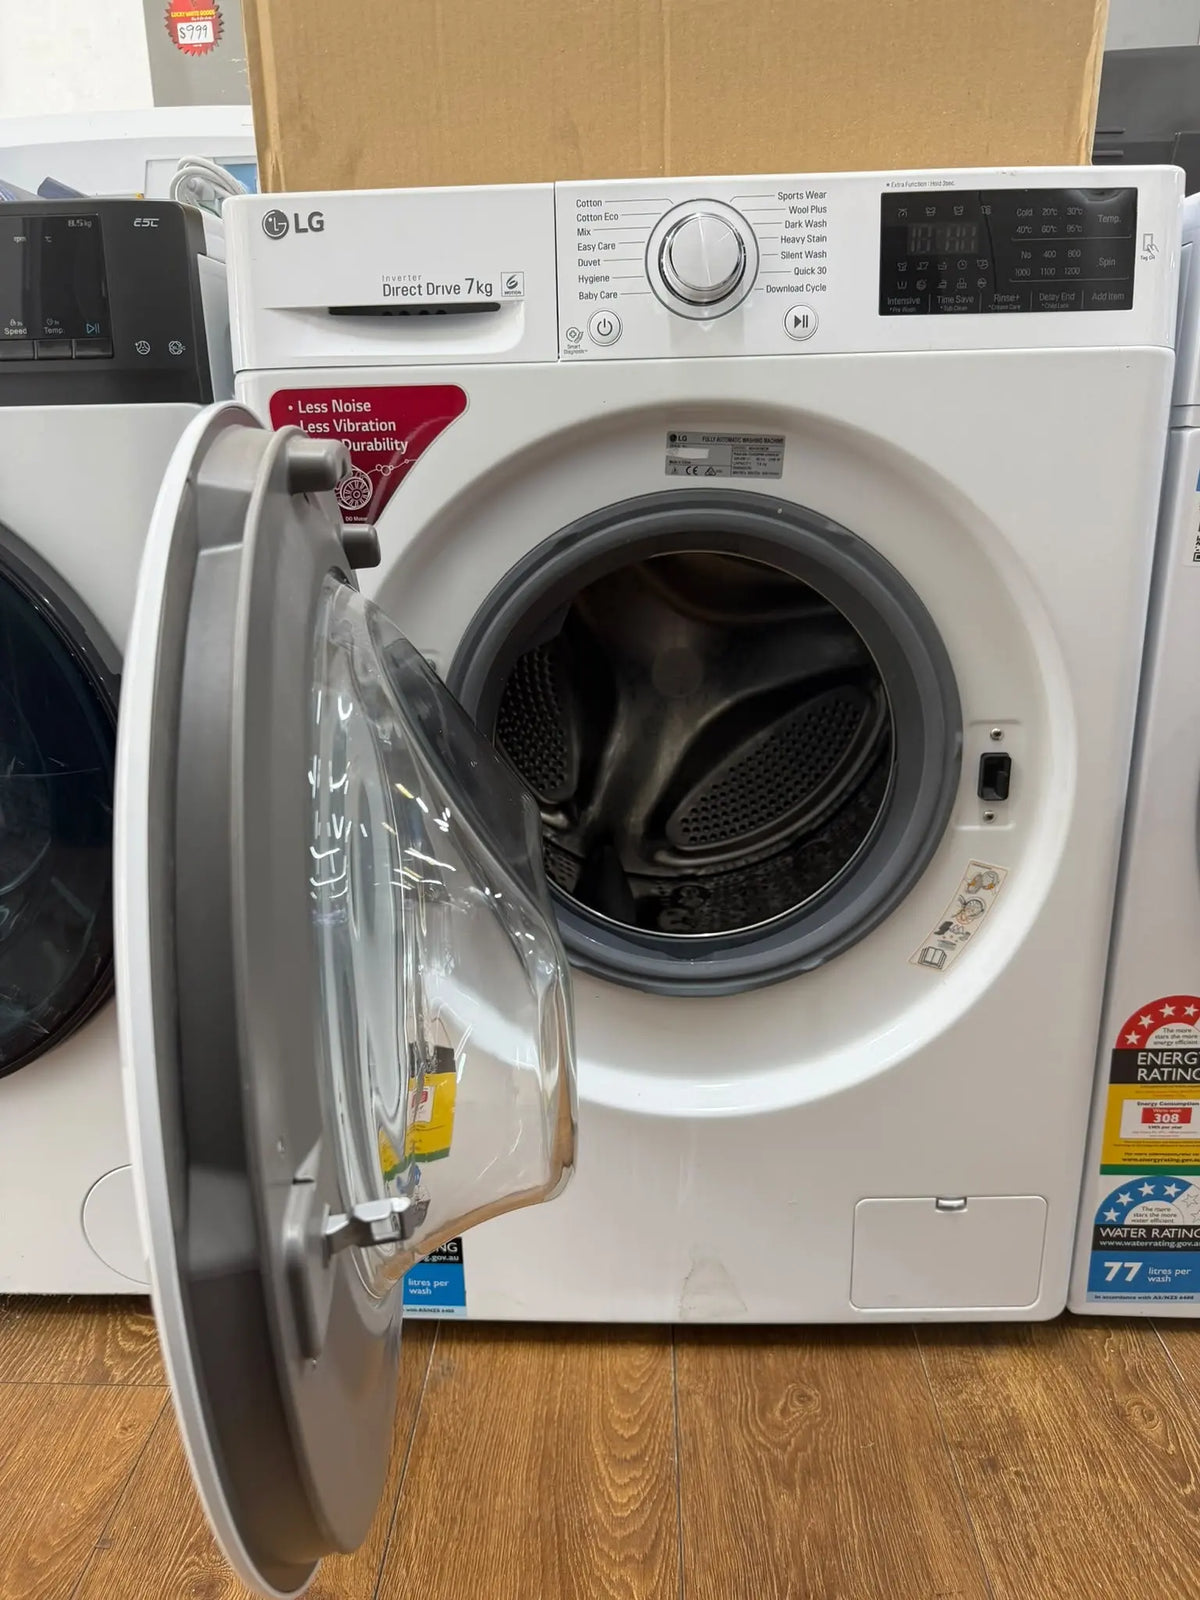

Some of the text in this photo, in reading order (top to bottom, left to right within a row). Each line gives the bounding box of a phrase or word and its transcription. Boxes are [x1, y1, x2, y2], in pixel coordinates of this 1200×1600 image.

[180, 24, 208, 40] $999
[778, 190, 827, 202] Sports Wear
[576, 198, 602, 208] Cotton
[788, 205, 827, 214] Wool Plus
[1016, 207, 1033, 217] Cold
[576, 212, 618, 222] Cotton Eco
[1098, 214, 1122, 224] Temp.
[294, 211, 325, 234] LG
[784, 219, 827, 229] Dark Wash
[577, 228, 592, 236] Mix
[780, 234, 827, 246] Heavy Stain
[578, 242, 616, 252] Easy Care
[780, 250, 827, 260] Silent Wash
[1021, 250, 1082, 260] No 400 800
[578, 258, 600, 268] Duvet
[1098, 258, 1116, 268] Spin
[794, 266, 827, 276] Quick 30
[1015, 266, 1080, 277] 1000 1100 1200
[382, 274, 422, 282] Inverter
[578, 274, 610, 284] Hygiene
[382, 283, 422, 297] Direct
[426, 282, 461, 296] Drive
[766, 284, 827, 294] Download Cycle
[578, 290, 618, 302] Baby Care
[888, 296, 920, 306] Intensive
[936, 294, 974, 304] Time Save
[994, 293, 1020, 304] Rinse+
[1039, 292, 1075, 303] Delay End
[1092, 292, 1124, 300] Add Item
[4, 328, 28, 336] Speed
[298, 399, 371, 414] Less Noise
[300, 419, 396, 433] Less Vibration
[342, 438, 408, 454] Durability
[1137, 1052, 1200, 1066] ENERG
[1153, 1113, 1180, 1123] 308
[1100, 1228, 1147, 1238] WATER
[1104, 1262, 1143, 1282] 77
[1148, 1267, 1192, 1276] litres per
[408, 1278, 450, 1288] litres per
[409, 1287, 432, 1295] wash
